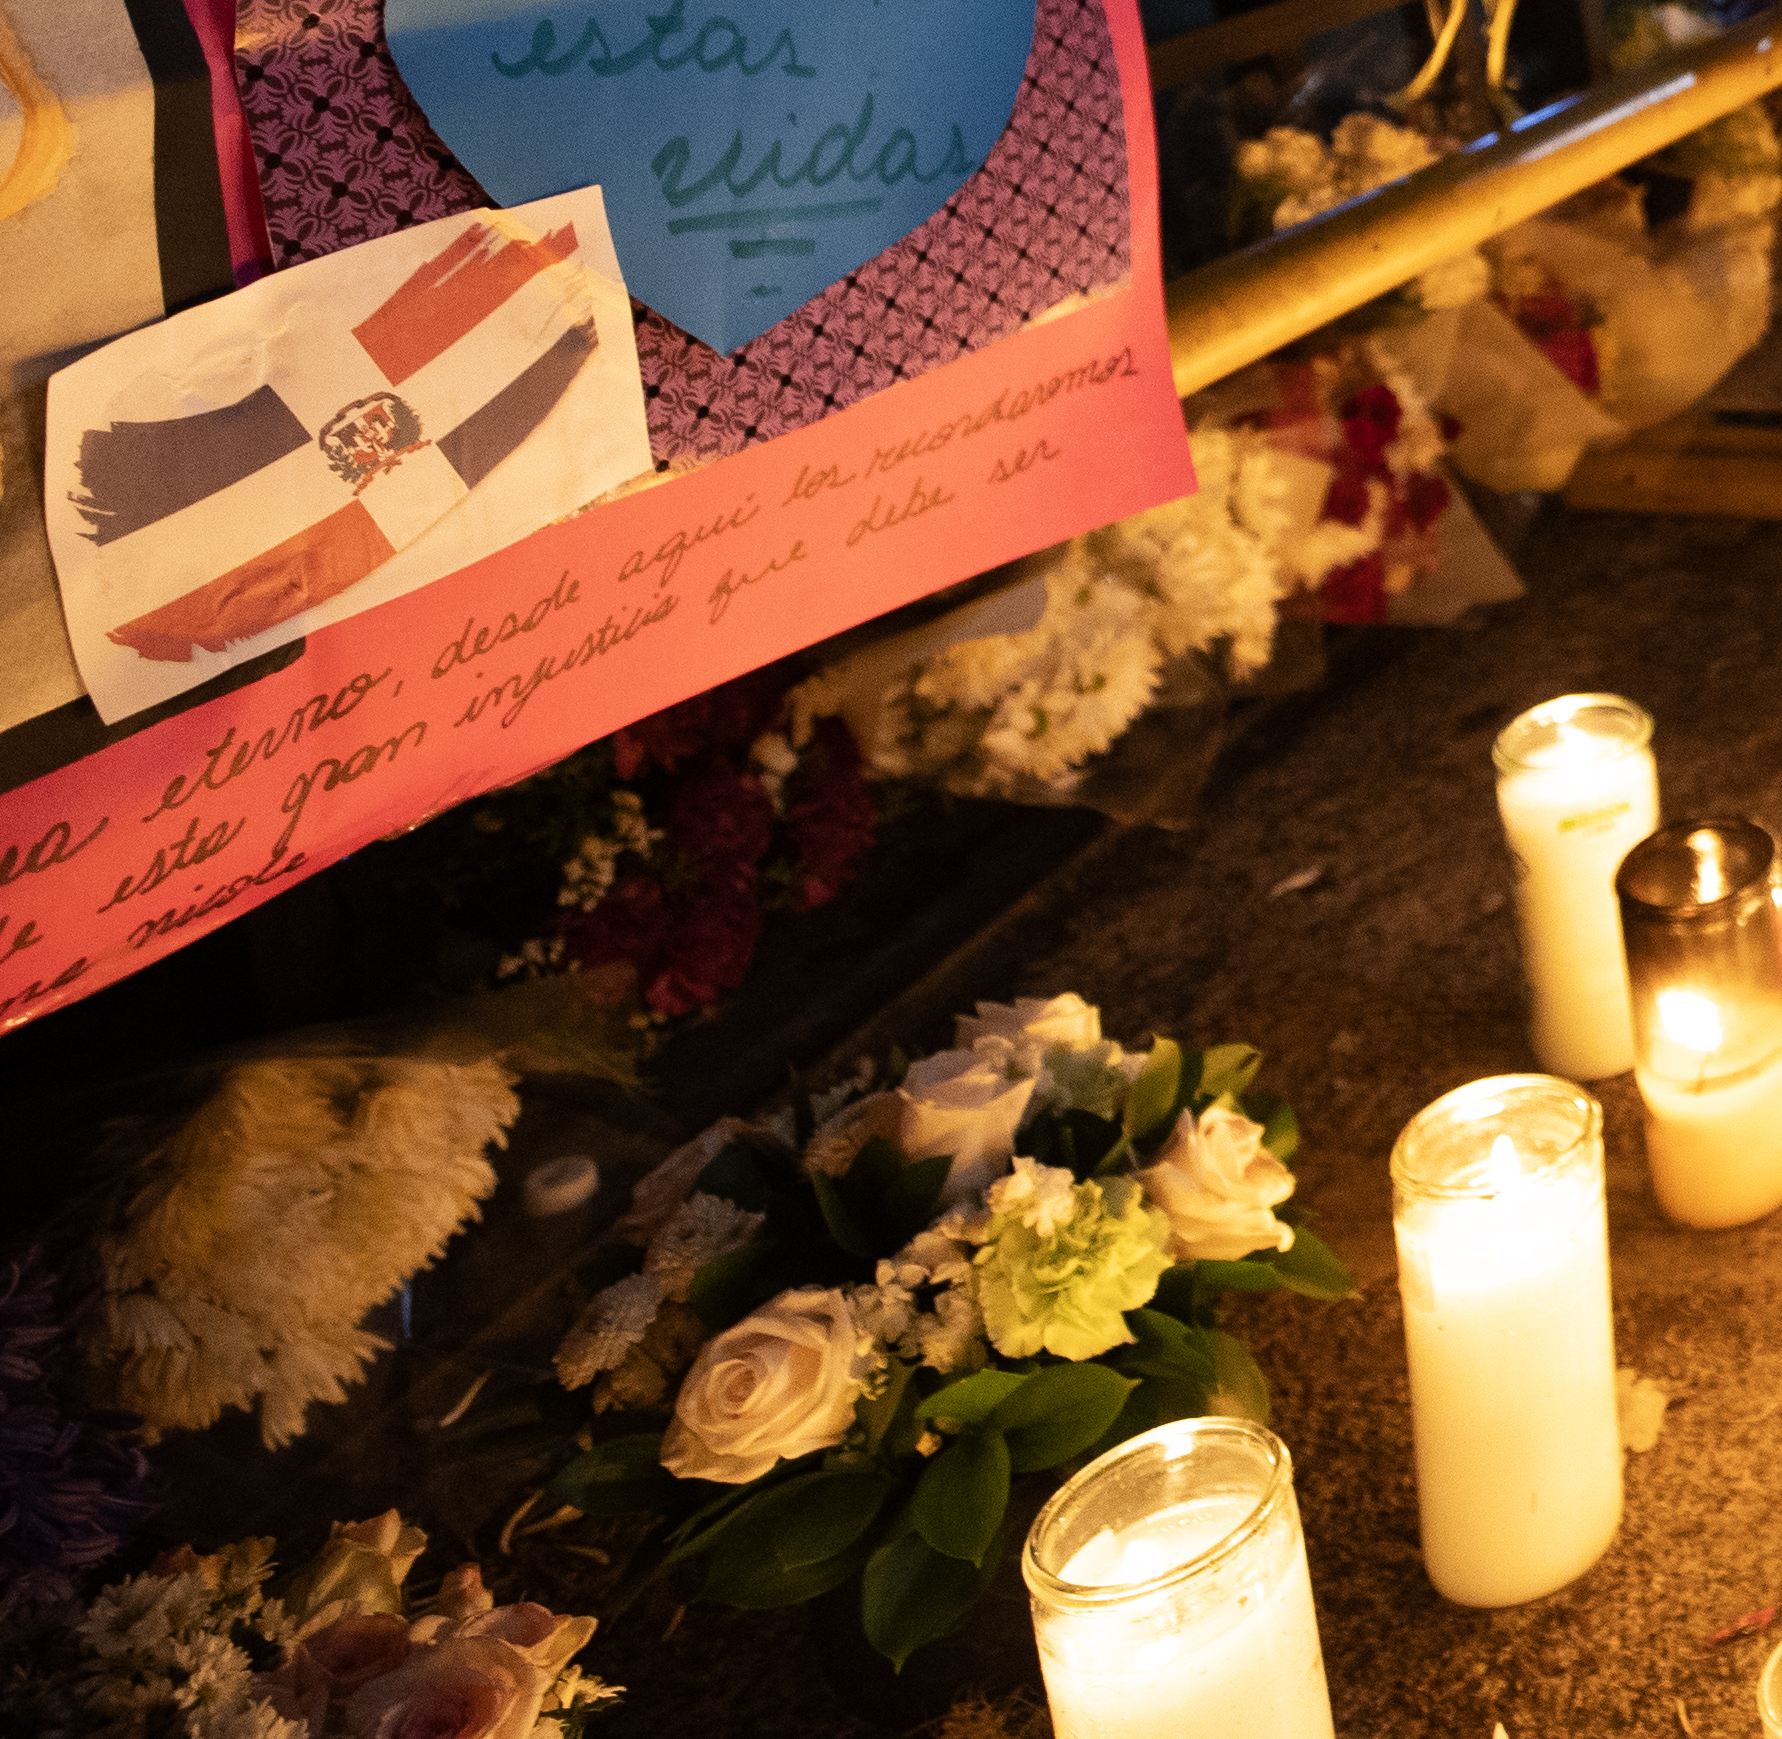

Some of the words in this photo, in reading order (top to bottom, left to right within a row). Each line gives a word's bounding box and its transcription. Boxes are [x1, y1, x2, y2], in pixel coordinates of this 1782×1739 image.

[271, 721, 428, 862] gran
[707, 539, 806, 626] que
[846, 475, 955, 549] debe
[986, 439, 1061, 485] ser
[431, 569, 580, 680] desde
[780, 464, 857, 506] los
